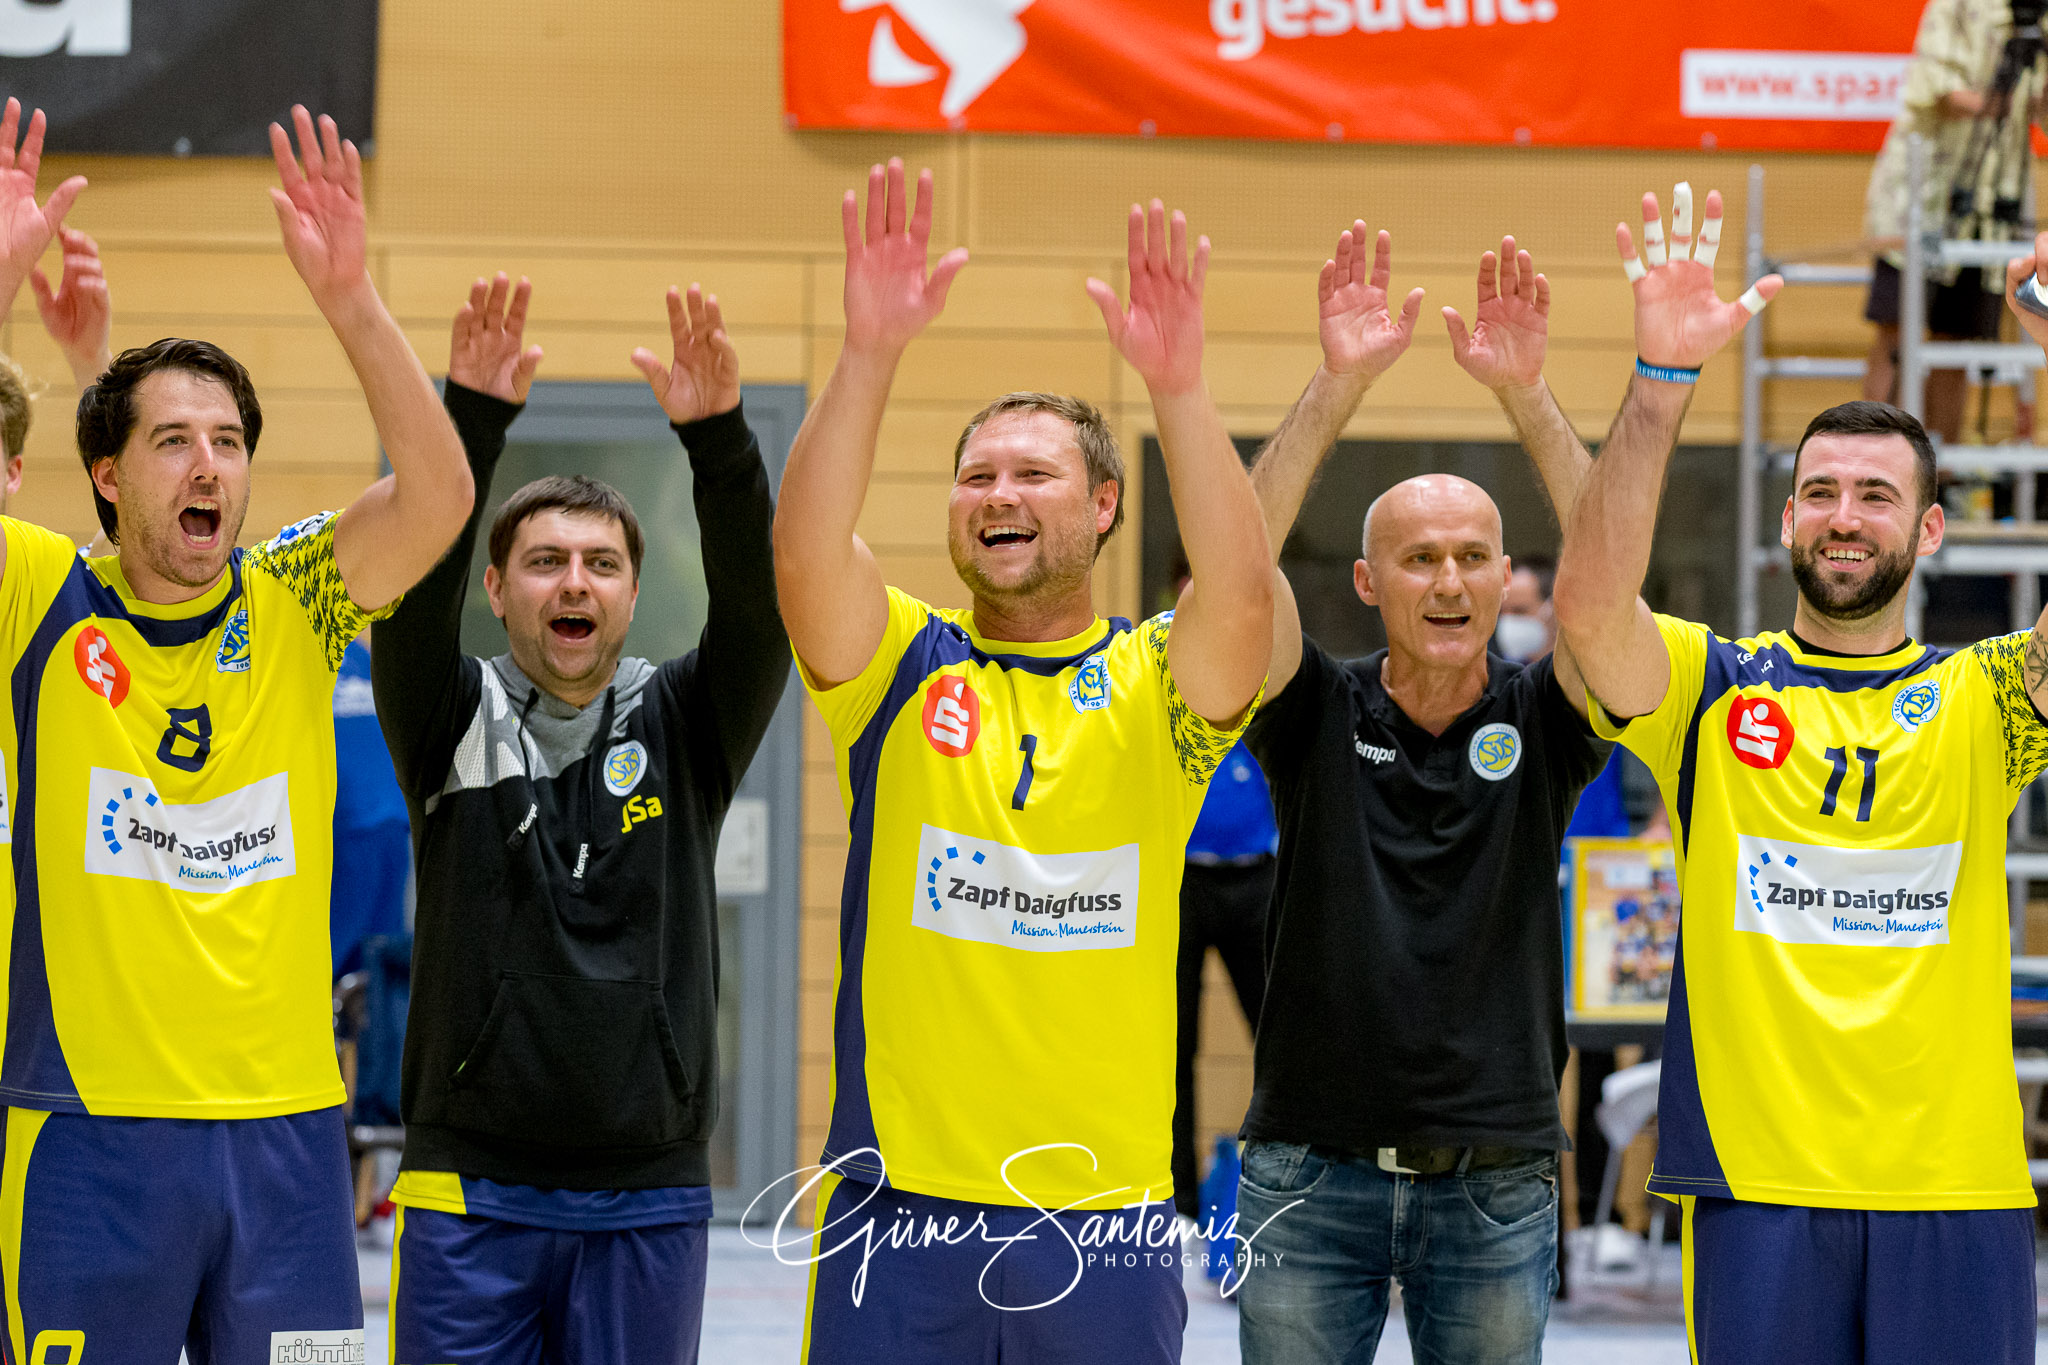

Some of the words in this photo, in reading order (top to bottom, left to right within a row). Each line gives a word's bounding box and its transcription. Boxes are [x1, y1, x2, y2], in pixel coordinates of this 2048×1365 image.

[235, 662, 250, 670] 196
[156, 703, 212, 772] 8
[1011, 734, 1037, 811] 1
[1819, 745, 1880, 822] 11
[518, 803, 538, 834] Kempa
[621, 794, 663, 834] JSa
[572, 843, 589, 878] Kempa
[947, 877, 1011, 911] Zapf
[1014, 891, 1122, 919] Daigfuss
[1766, 882, 1827, 911] Zapf
[1833, 888, 1949, 915] Daigfuss
[1833, 916, 1884, 932] Mission:
